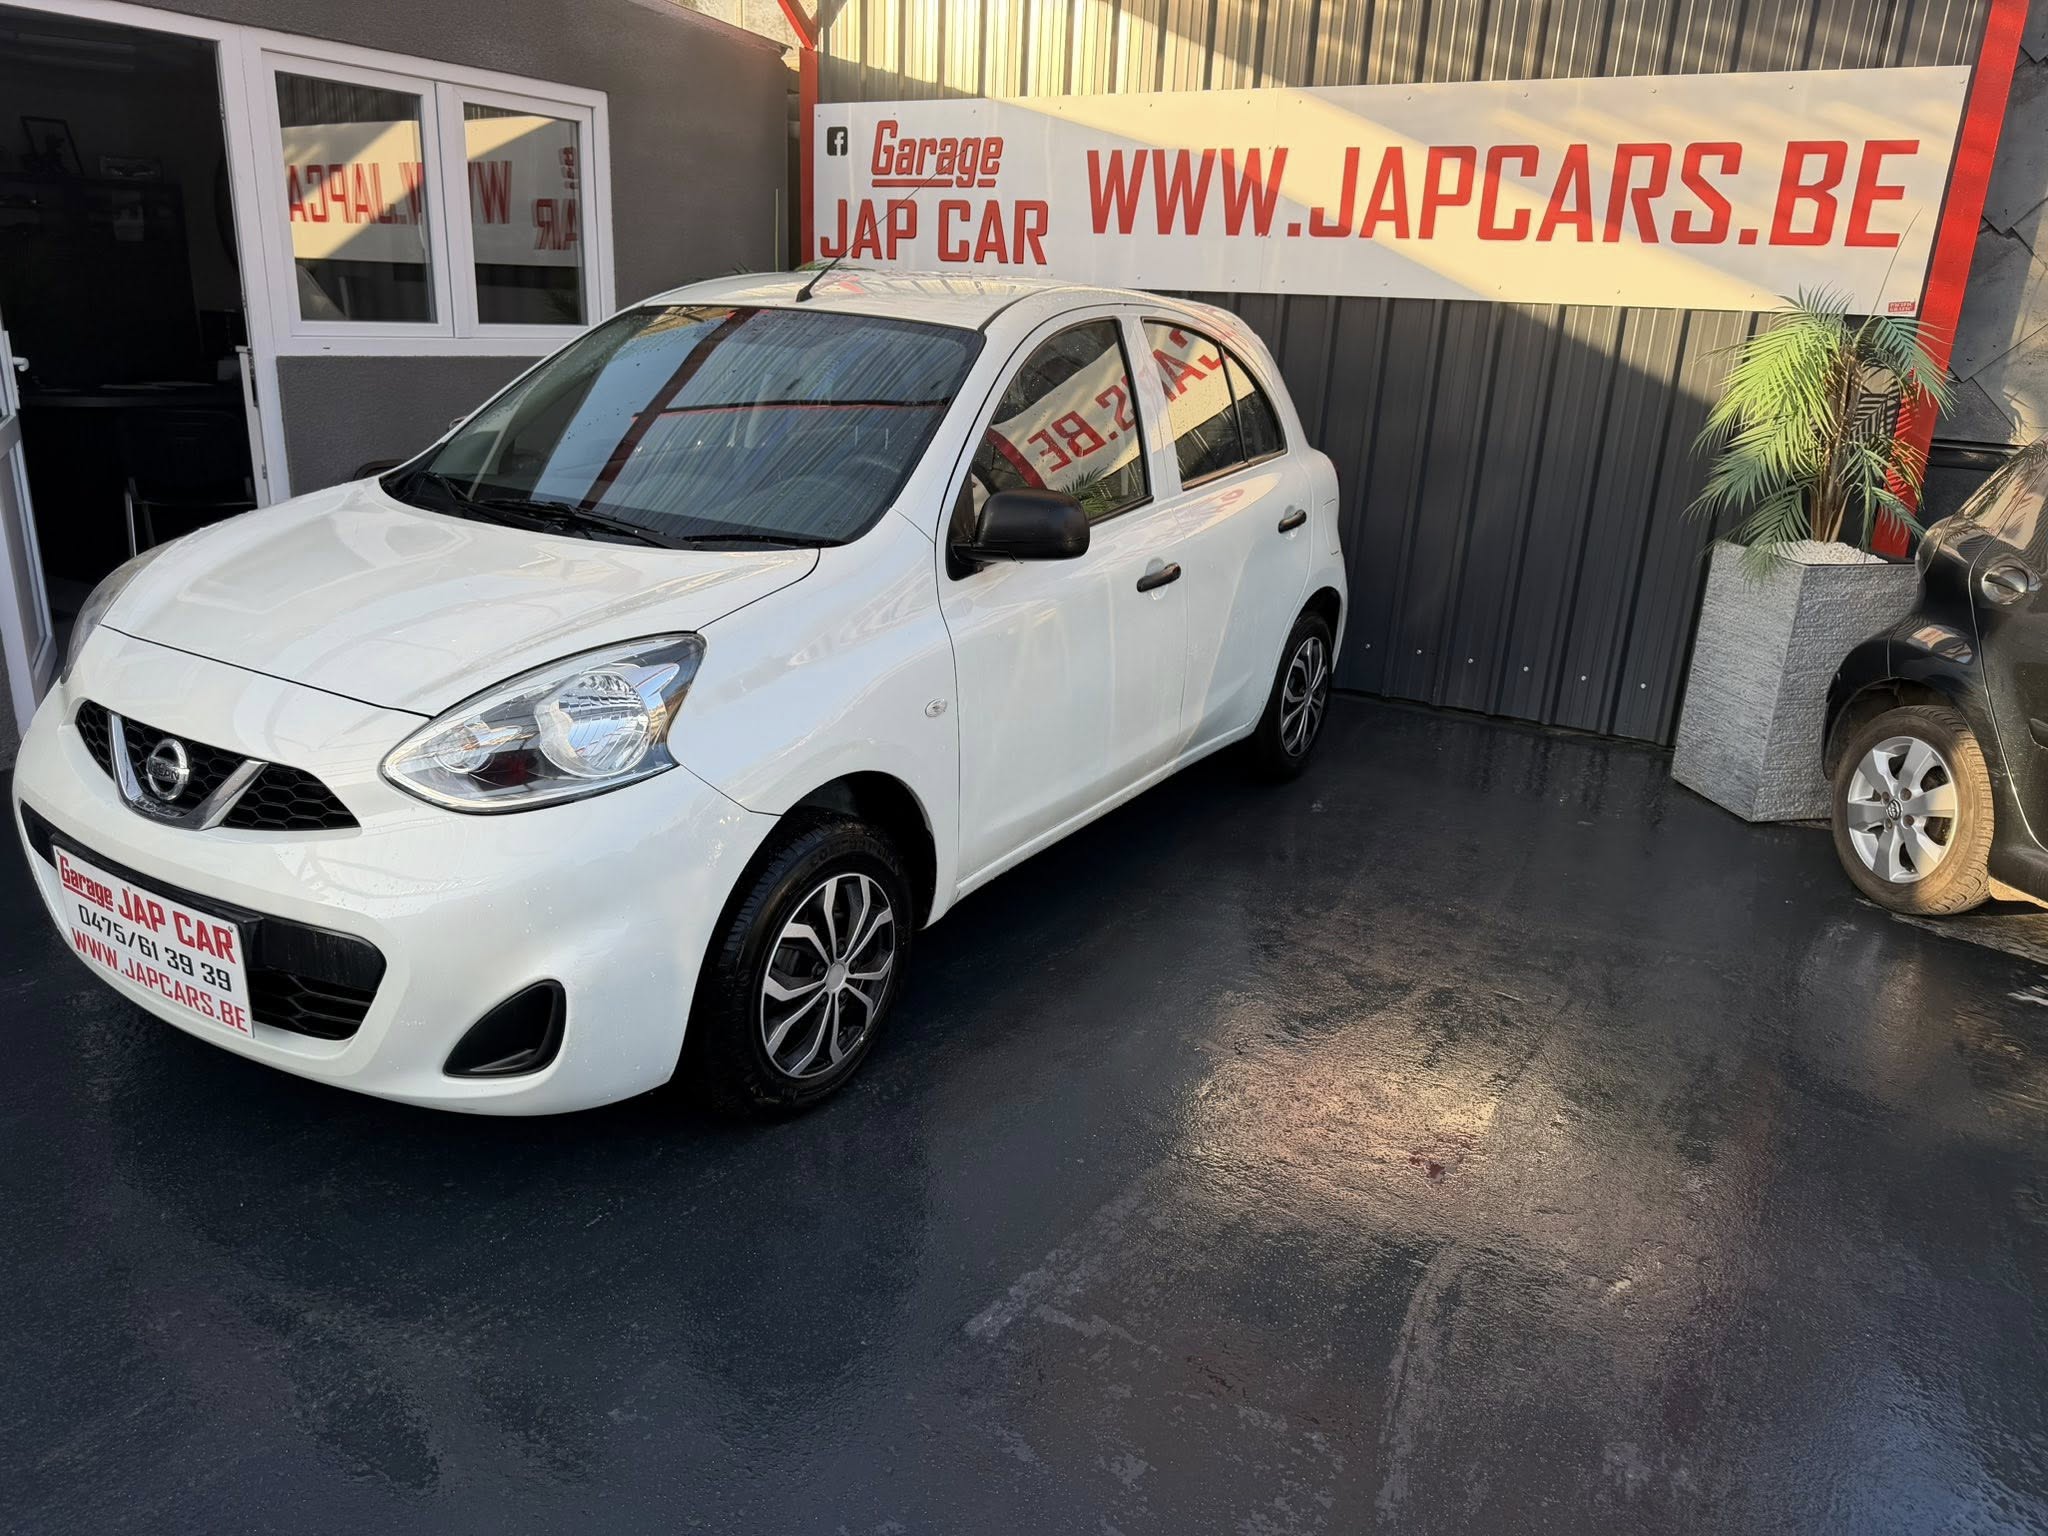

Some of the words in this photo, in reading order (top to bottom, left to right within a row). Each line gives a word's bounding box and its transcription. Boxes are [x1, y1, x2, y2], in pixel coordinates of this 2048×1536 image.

[872, 120, 1004, 188] Garage
[1087, 138, 1920, 248] WWW.JAPCARS.BE
[820, 199, 918, 260] JAP
[938, 199, 1049, 265] CAR
[60, 855, 114, 912] Garage
[118, 888, 166, 933] JAP
[173, 910, 237, 965] CAR
[78, 904, 160, 962] 0475/61
[165, 947, 195, 977] 39
[200, 962, 232, 993] 39
[71, 927, 248, 1033] WWW.JAPCARS.BE
